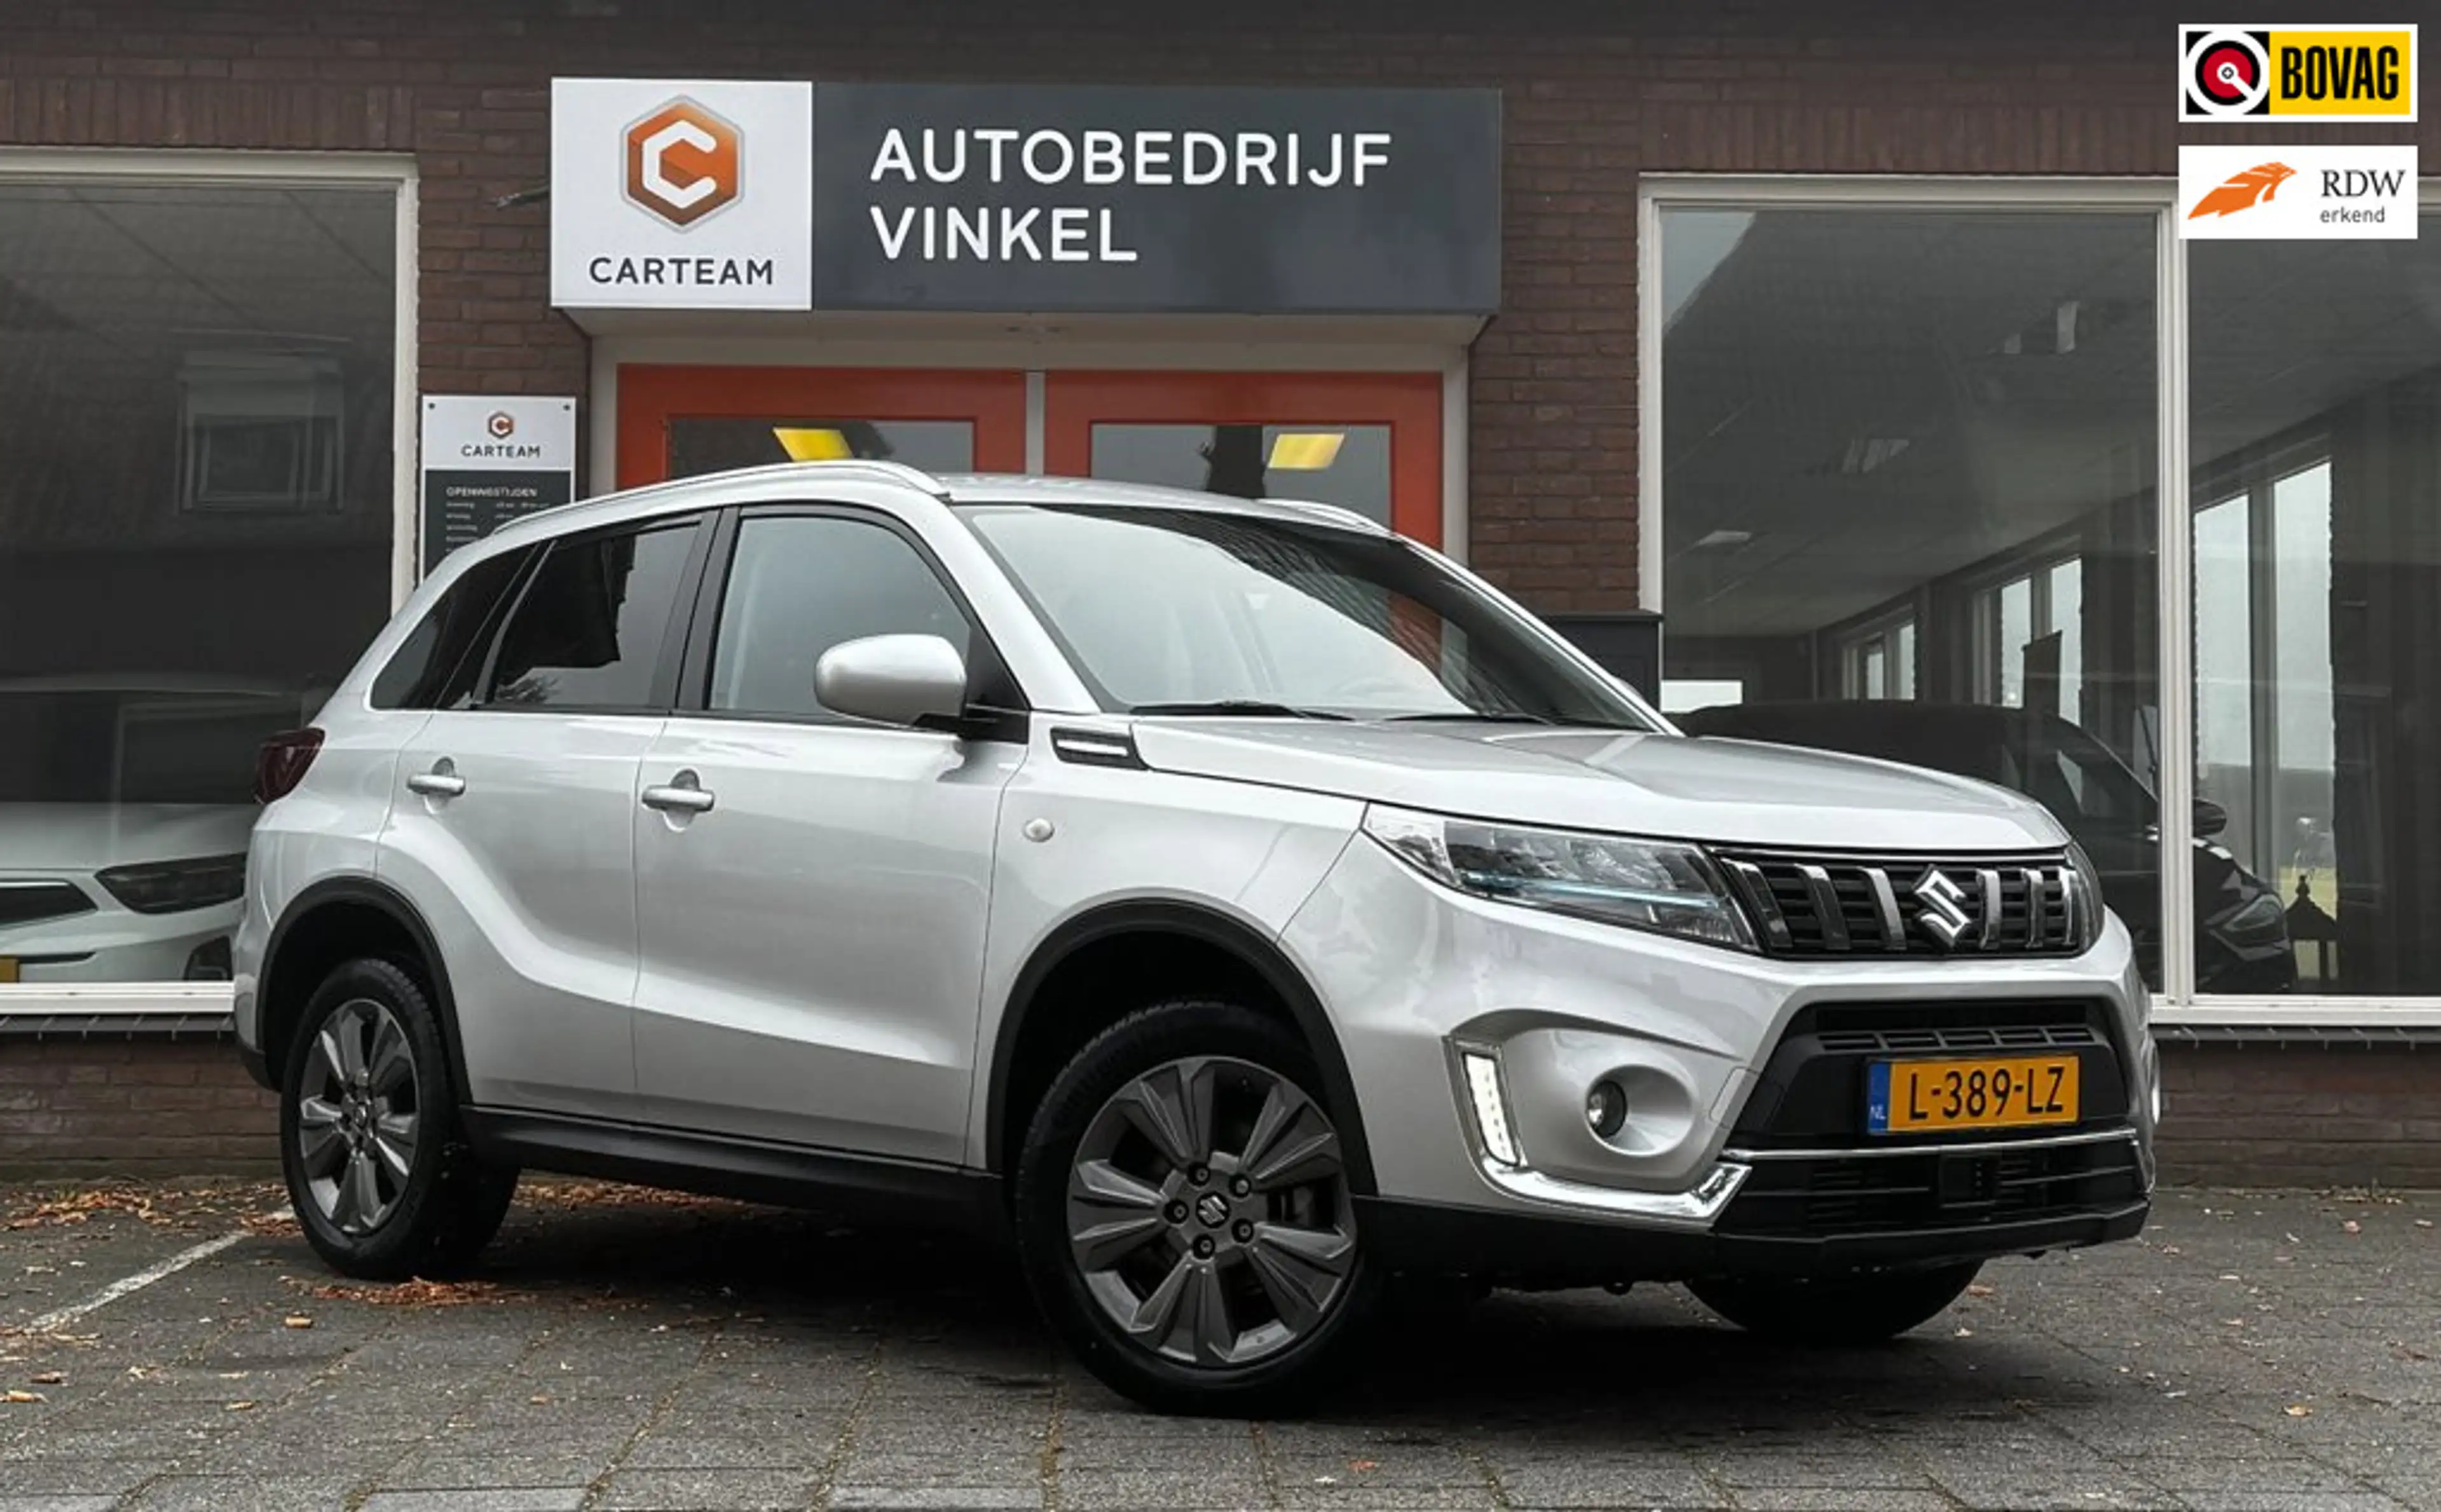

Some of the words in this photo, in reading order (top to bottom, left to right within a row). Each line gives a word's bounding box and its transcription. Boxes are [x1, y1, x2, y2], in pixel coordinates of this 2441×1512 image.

[871, 128, 1391, 187] AUTOBEDRIJF
[870, 206, 1137, 261] VINKEL
[589, 257, 773, 285] CARTEAM
[460, 445, 541, 458] CARTEAM
[1870, 1105, 1887, 1120] NL
[1909, 1066, 2065, 1121] L-389-LZ
